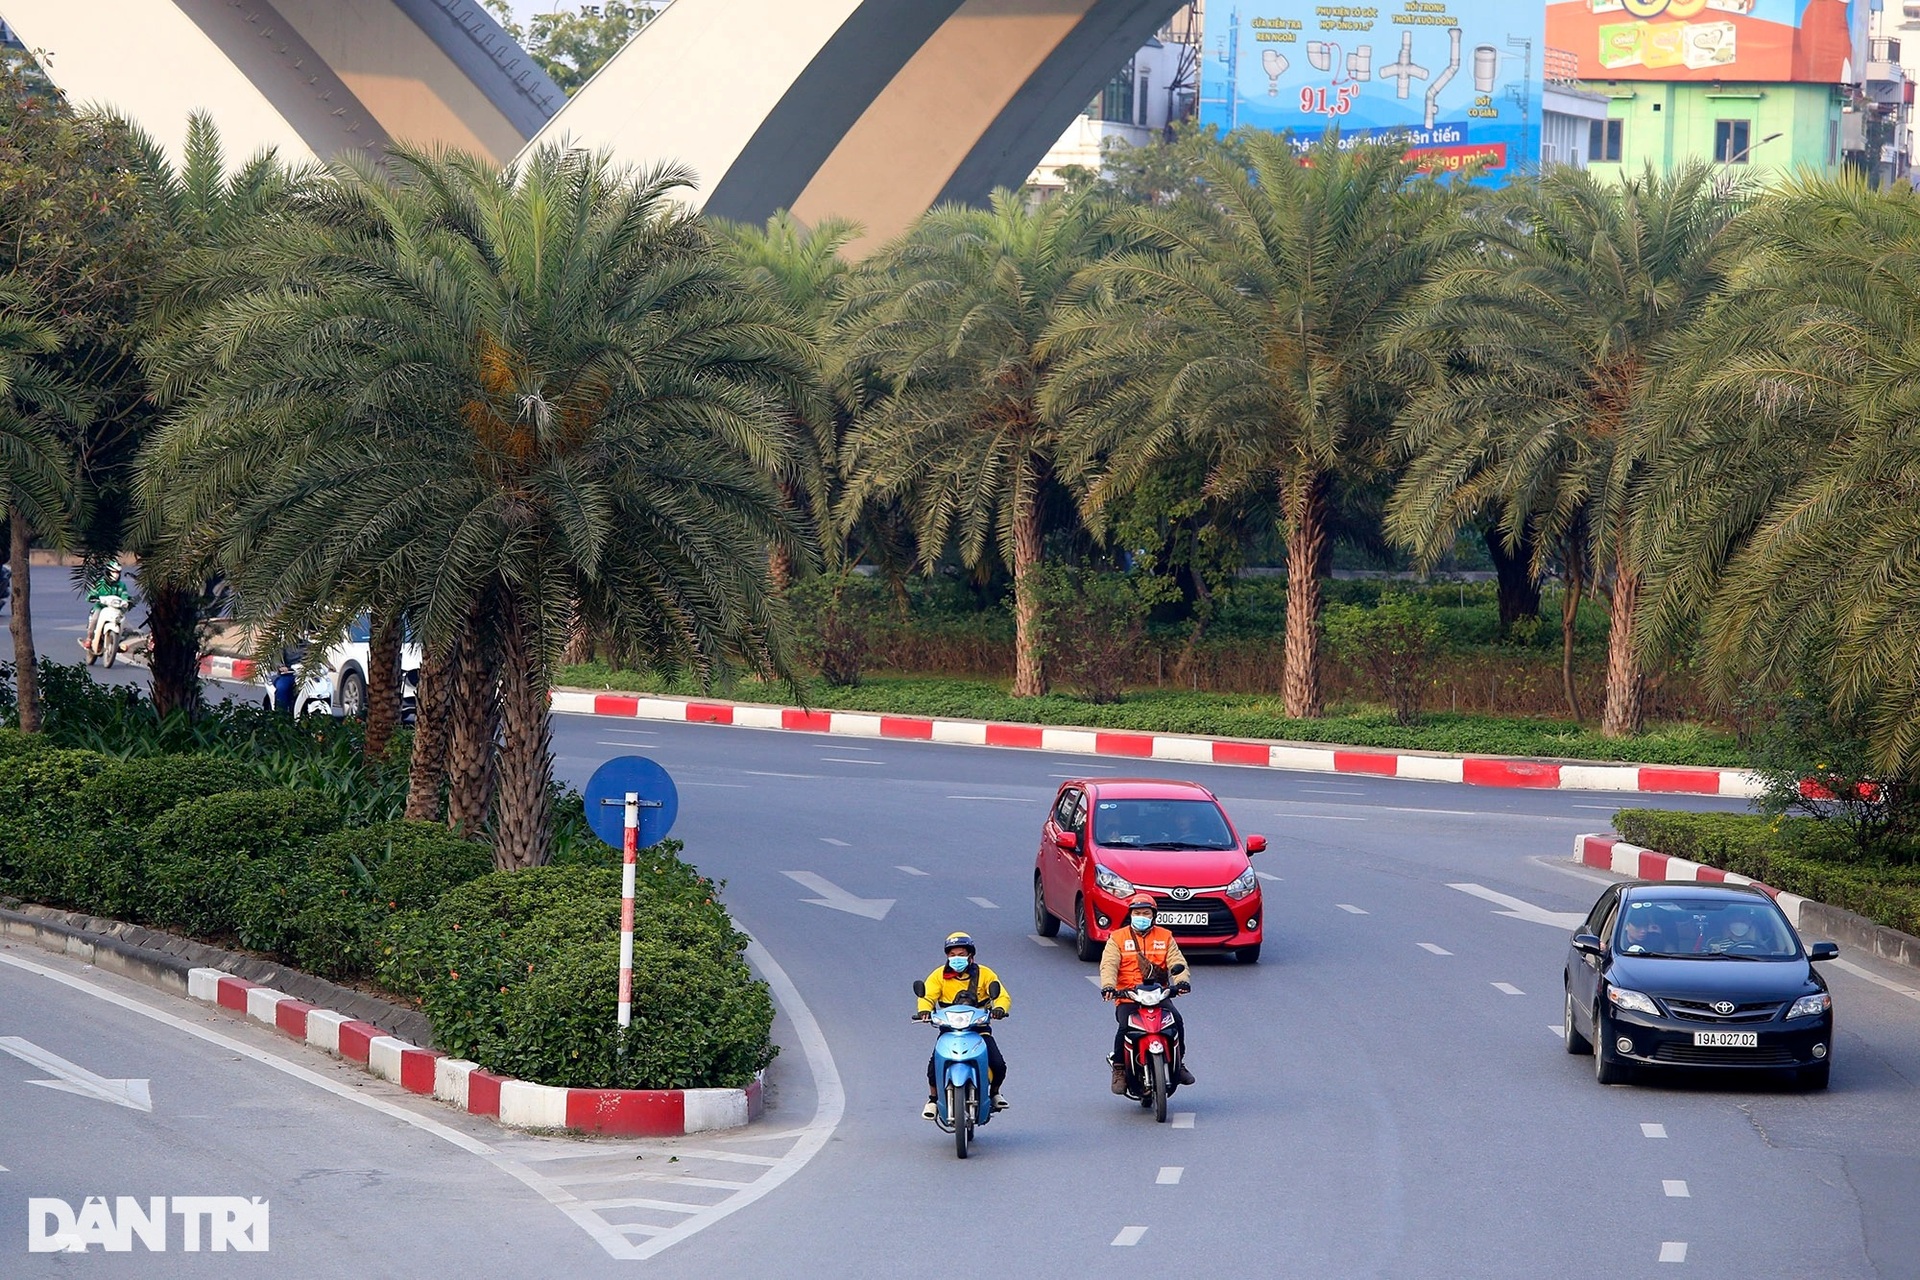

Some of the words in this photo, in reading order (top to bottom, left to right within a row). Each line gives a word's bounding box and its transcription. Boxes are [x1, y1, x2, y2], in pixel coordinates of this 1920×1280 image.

[1287, 19, 1302, 30] TRA
[1256, 32, 1271, 42] REN
[1432, 126, 1460, 143] tiến
[1157, 913, 1207, 924] 30G-217.05
[1698, 1033, 1756, 1046] 19A-027.02
